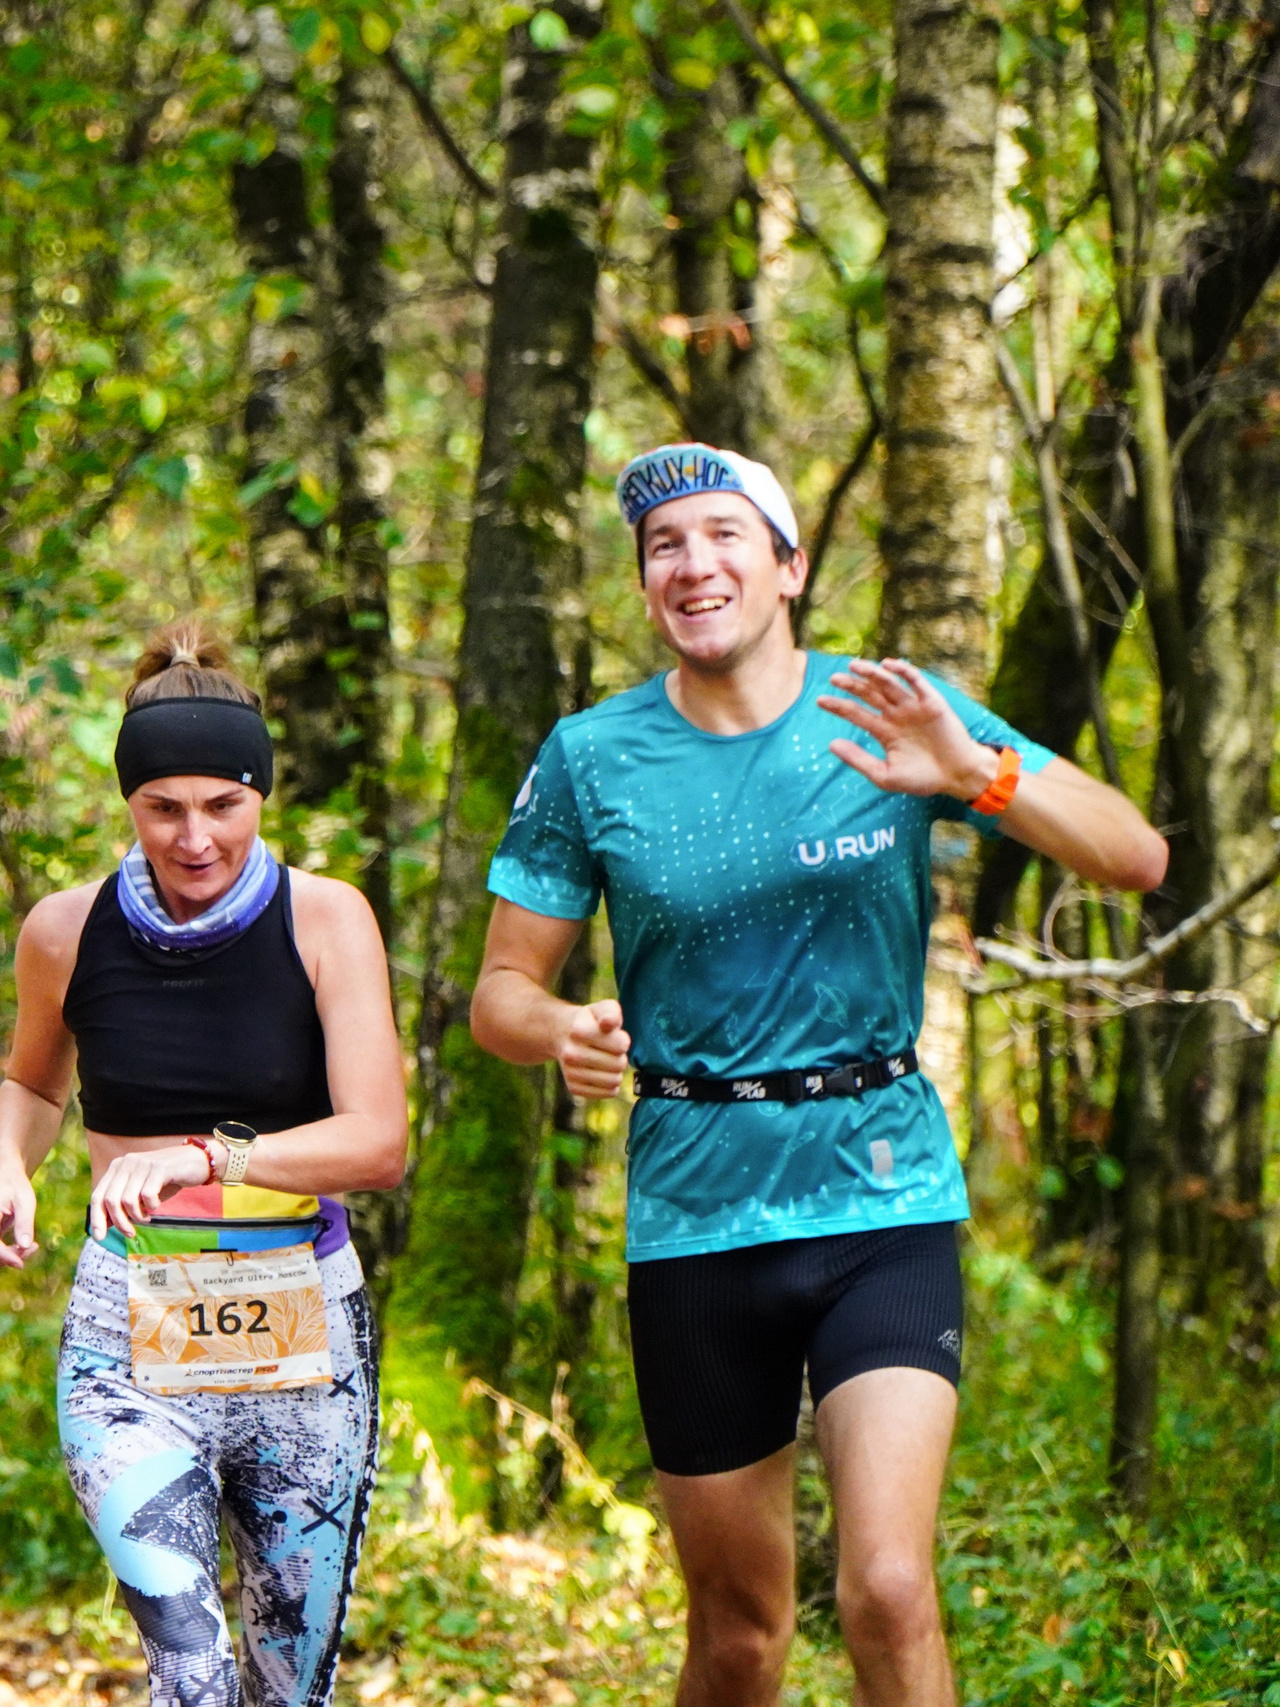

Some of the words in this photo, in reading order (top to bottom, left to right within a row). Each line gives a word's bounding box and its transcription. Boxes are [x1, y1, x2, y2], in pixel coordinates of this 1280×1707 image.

[798, 840, 826, 866] U
[835, 825, 895, 860] RUN
[203, 1276, 244, 1286] Backyard
[247, 1274, 273, 1282] Ultra
[278, 1270, 307, 1280] Moscow
[188, 1299, 270, 1337] 162
